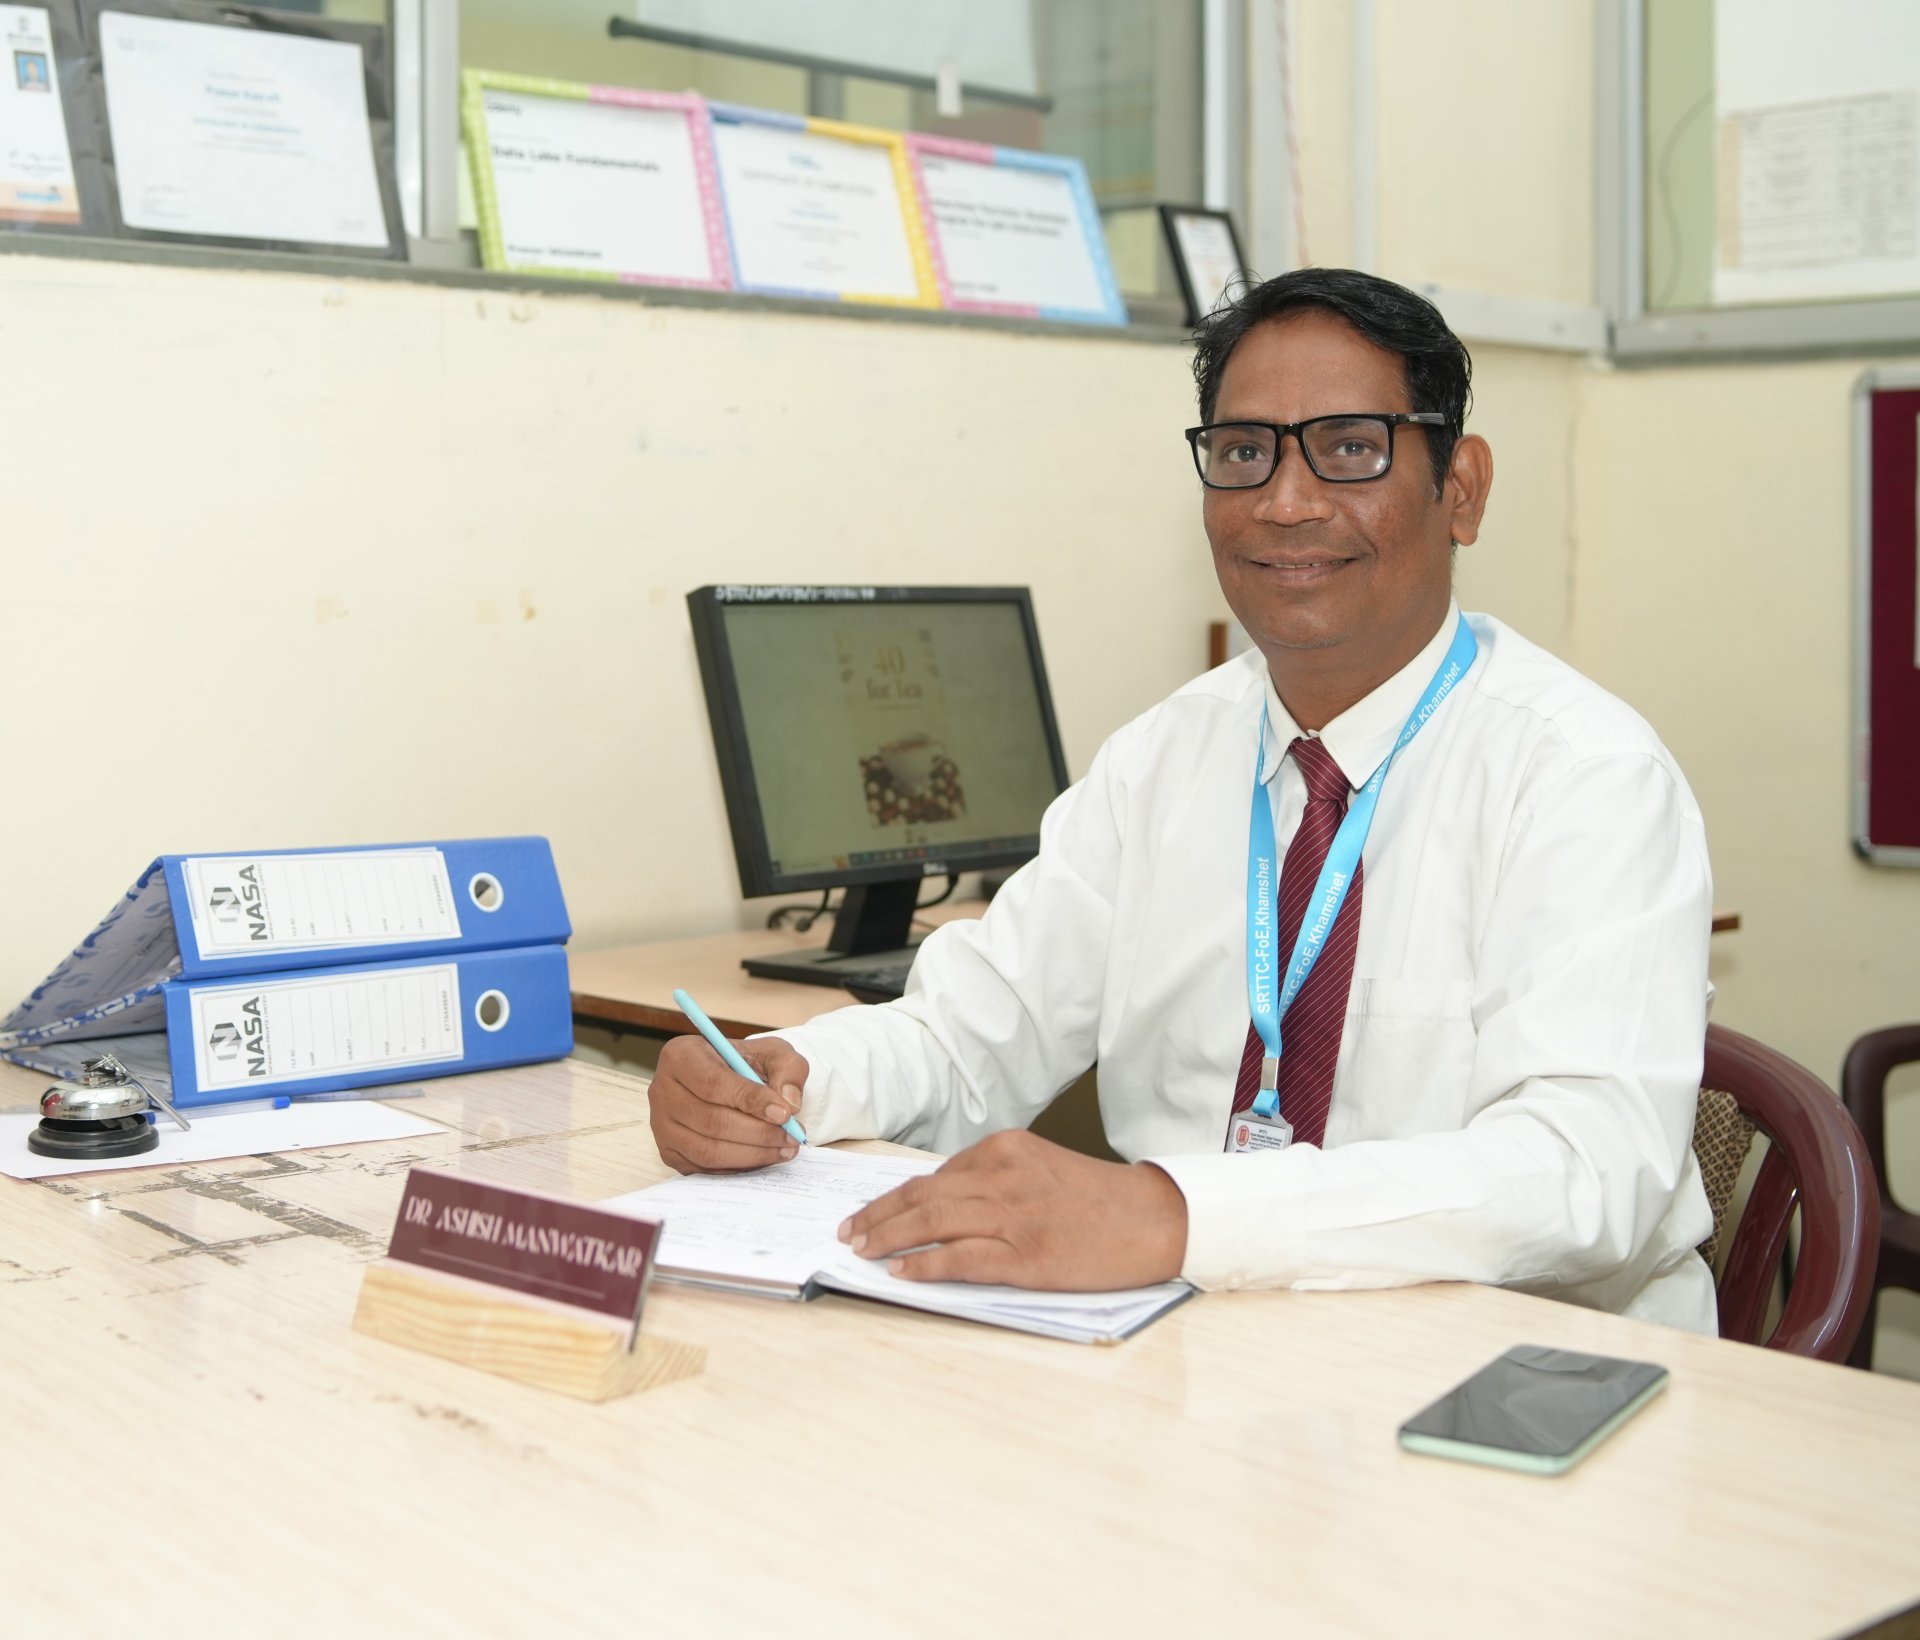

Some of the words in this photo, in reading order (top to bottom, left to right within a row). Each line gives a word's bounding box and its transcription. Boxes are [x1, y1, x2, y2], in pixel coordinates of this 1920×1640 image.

[239, 864, 267, 941] NASA
[1254, 857, 1272, 1015] SRTTC-FoE,Khamshet
[242, 996, 267, 1077] NASA
[435, 1205, 503, 1246] ASHISH
[502, 1222, 642, 1277] MANWATKAR
